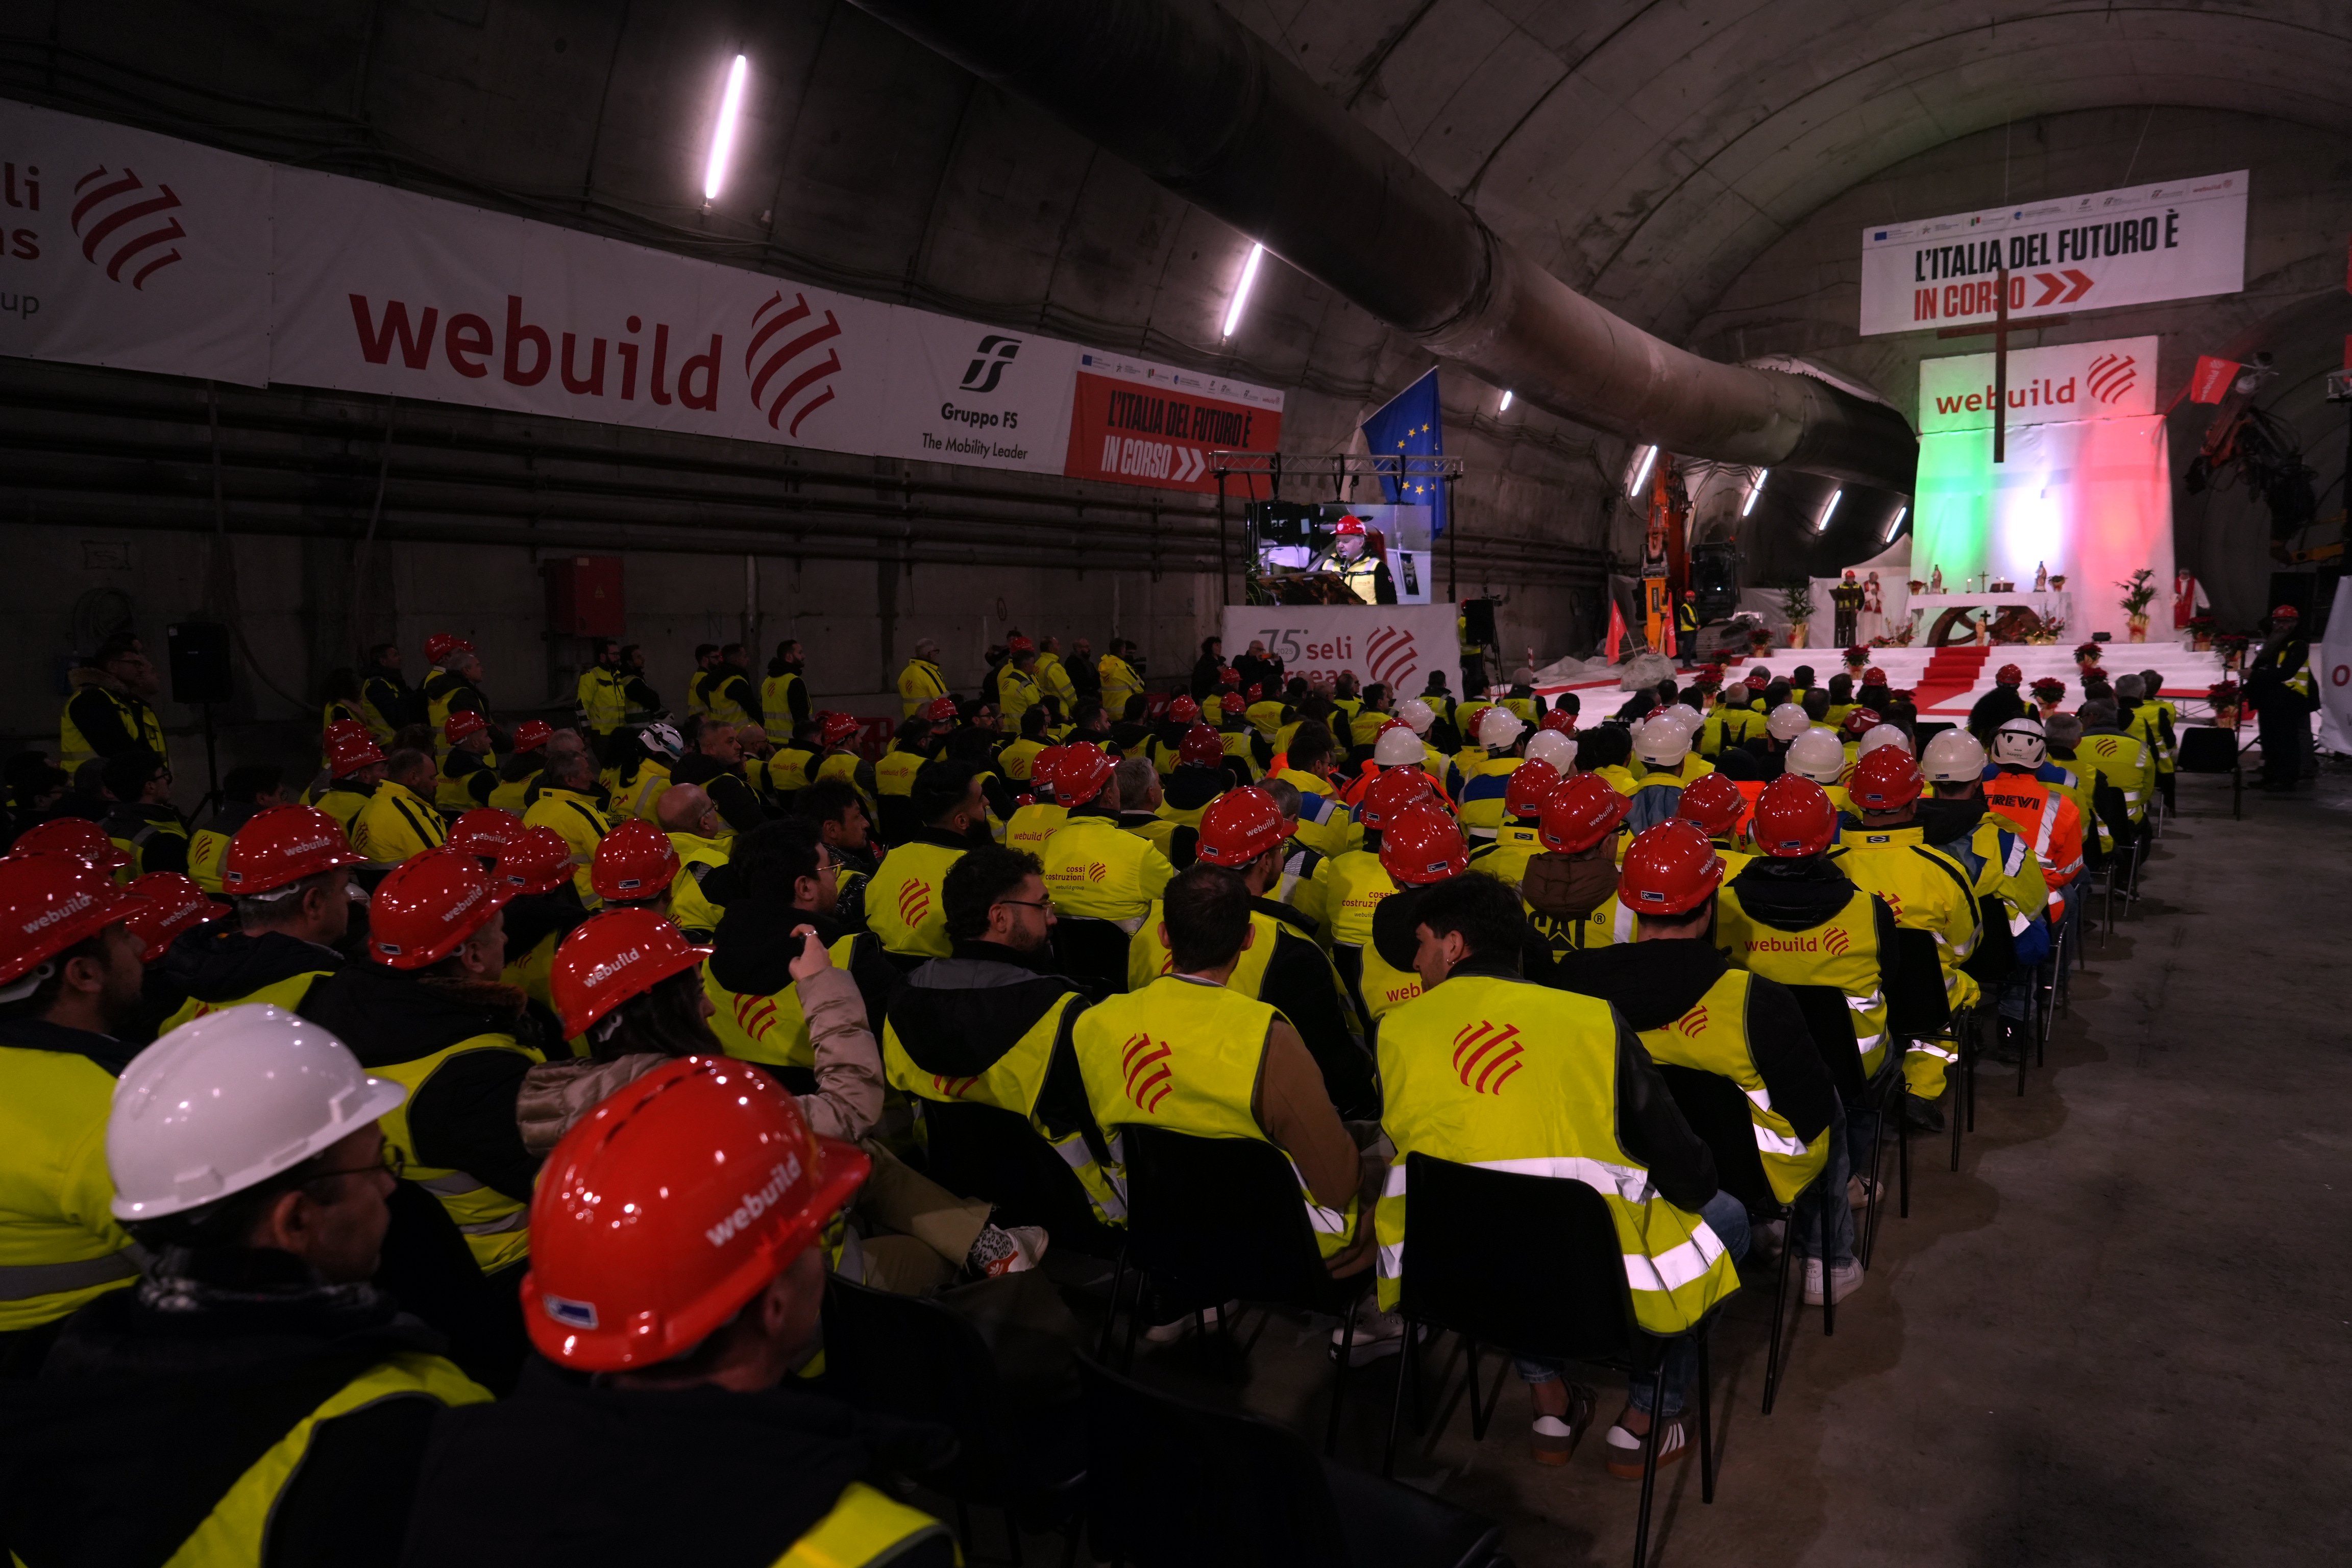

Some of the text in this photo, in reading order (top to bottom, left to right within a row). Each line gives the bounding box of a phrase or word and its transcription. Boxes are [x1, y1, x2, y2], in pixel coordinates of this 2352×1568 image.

[1916, 209, 2178, 282] L'ITALIA DEL FUTURO È
[1914, 287, 1938, 322] IN
[349, 293, 722, 412] webuild
[1936, 377, 2075, 414] webuild
[941, 402, 1018, 429] Gruppo FS
[1108, 390, 1253, 448] L'ITALIA DEL FUTURO È
[922, 433, 1028, 460] The Mobility Leader
[1100, 435, 1173, 480] IN CORSO
[1306, 635, 1352, 660] seli
[1245, 817, 1276, 837] webuild
[1588, 802, 1614, 827] webuild
[283, 836, 331, 856] webuild
[471, 832, 507, 844] webuild
[1014, 831, 1042, 841] webuild
[1045, 873, 1085, 881] costruzioni
[22, 893, 93, 934] webuild
[159, 900, 199, 927] webuild
[441, 885, 484, 923] webuild
[1342, 899, 1378, 908] costruzi
[1744, 937, 1818, 952] webuild
[582, 947, 641, 989] webuild
[1386, 982, 1424, 1003] web
[705, 1152, 802, 1247] webuild
